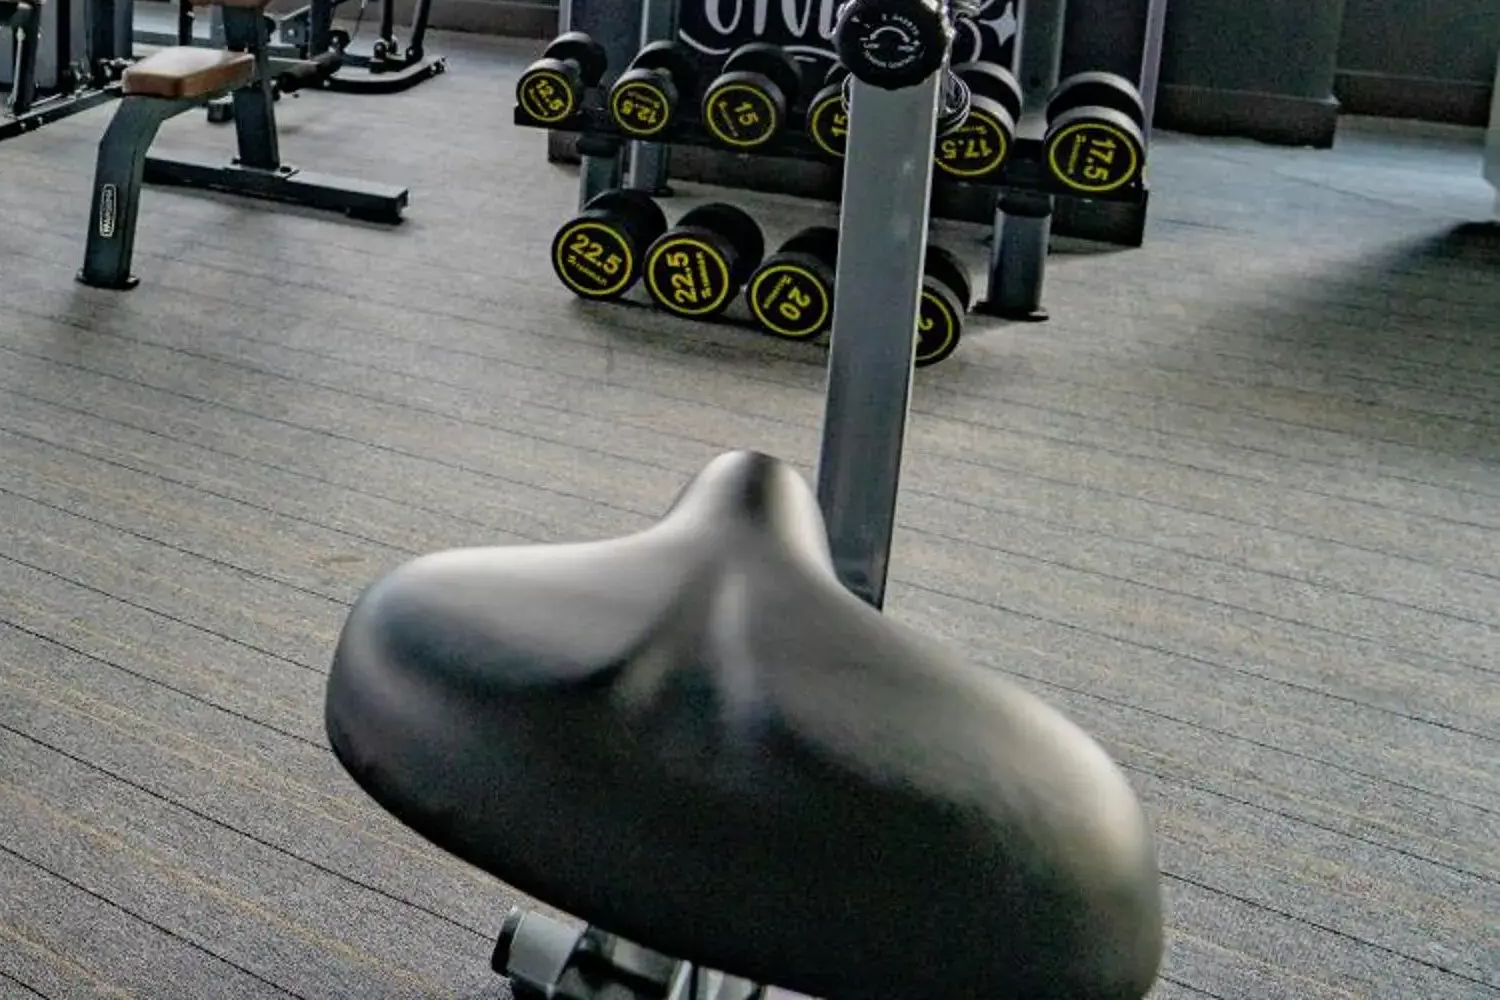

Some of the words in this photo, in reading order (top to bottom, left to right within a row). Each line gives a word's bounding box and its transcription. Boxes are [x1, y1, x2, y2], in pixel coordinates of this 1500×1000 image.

[734, 101, 759, 127] 15
[940, 138, 993, 160] 17.5
[1083, 137, 1117, 181] 17.5
[570, 233, 624, 276] 22.5
[666, 251, 698, 304] 22.5
[779, 285, 811, 321] 20
